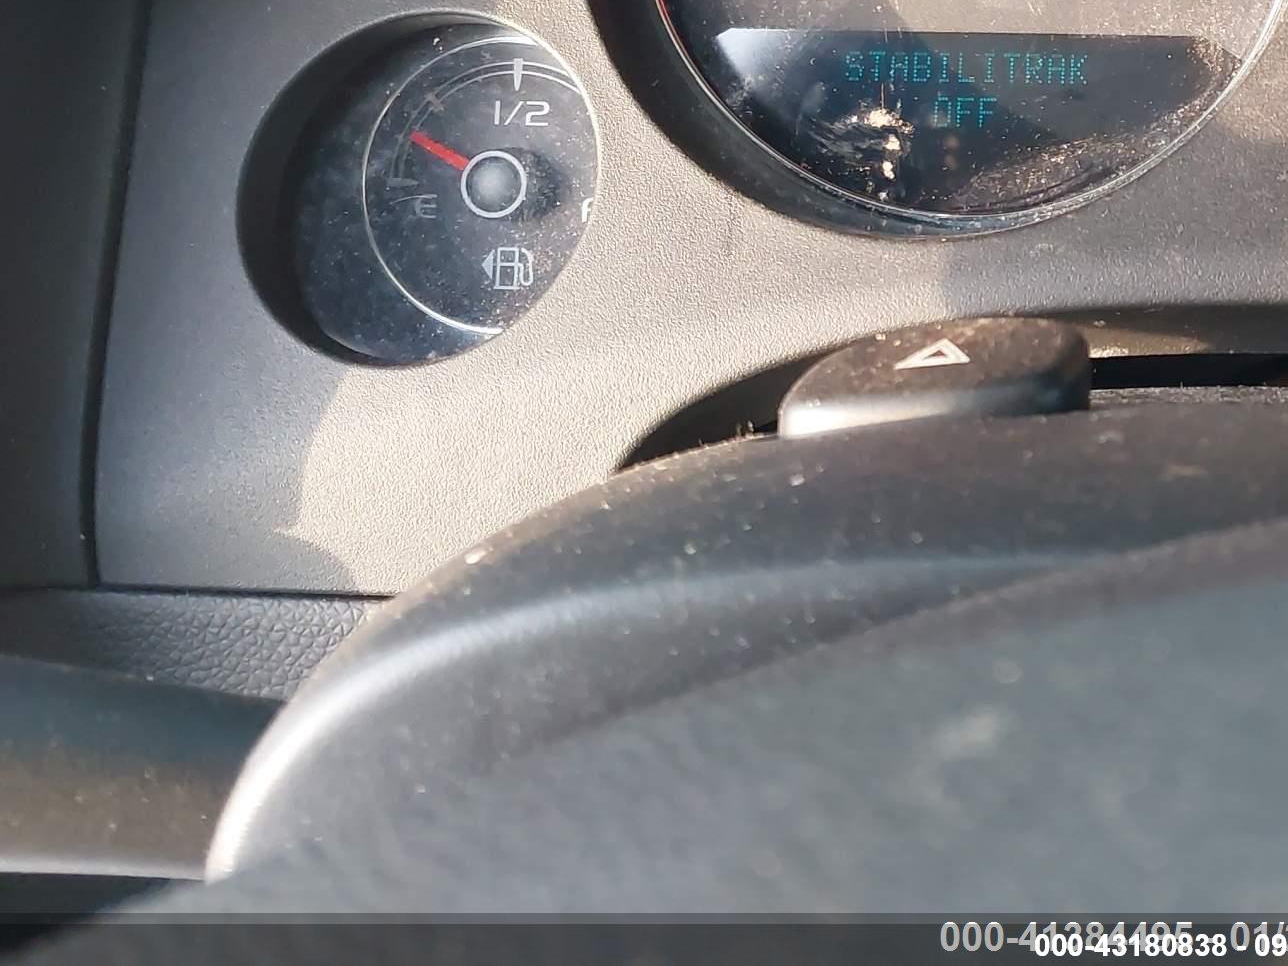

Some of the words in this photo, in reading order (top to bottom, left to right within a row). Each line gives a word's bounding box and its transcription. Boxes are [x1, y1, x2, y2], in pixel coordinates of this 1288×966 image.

[844, 50, 1089, 86] STABILITRAK
[494, 100, 550, 126] 1/2
[931, 97, 998, 129] OFF
